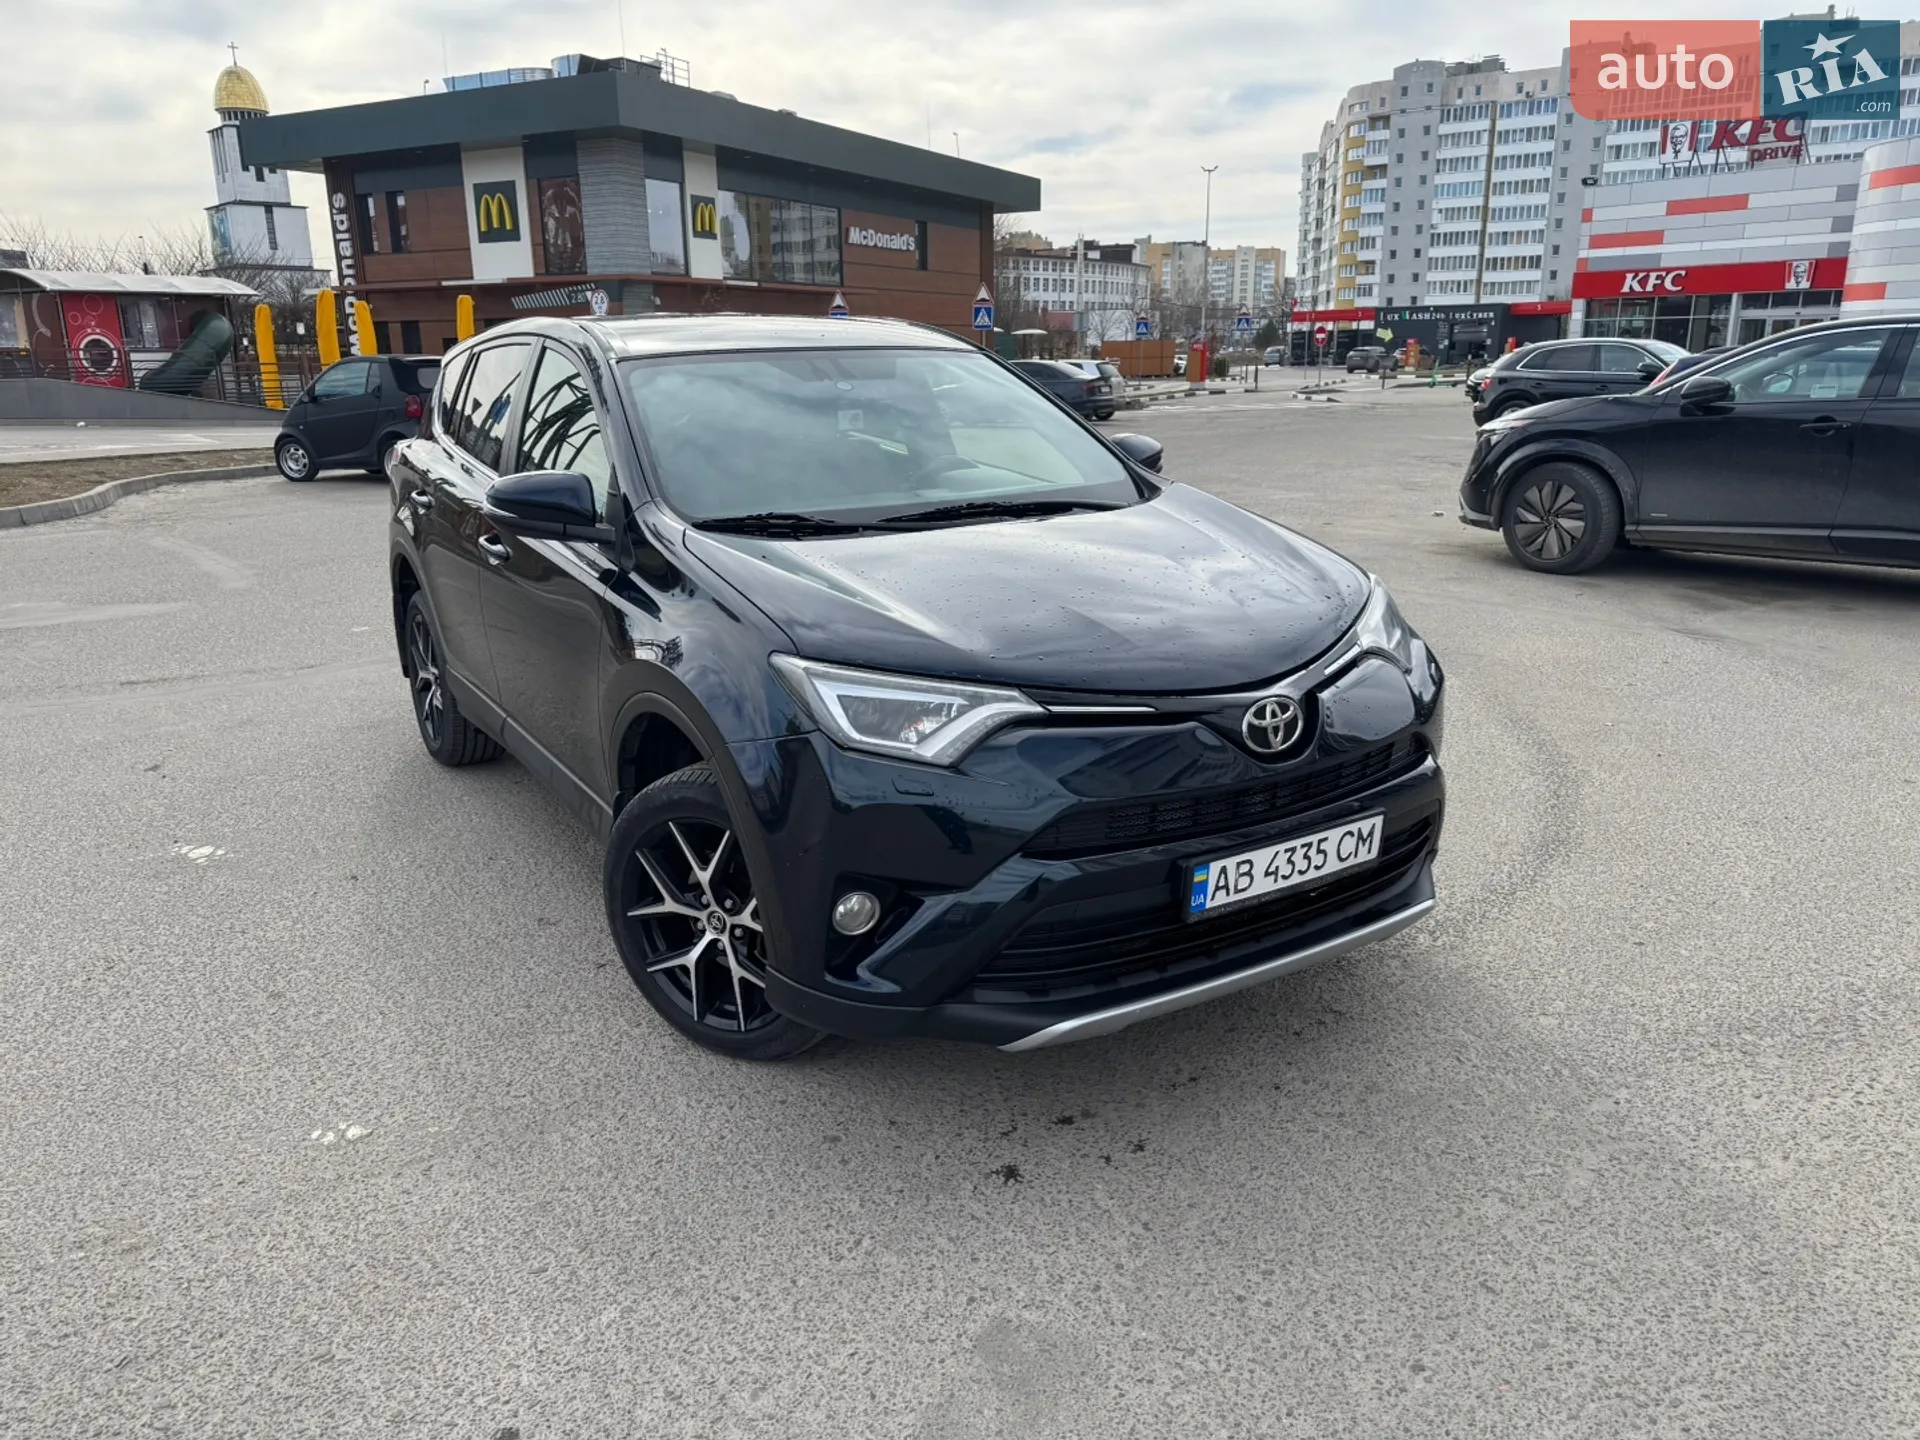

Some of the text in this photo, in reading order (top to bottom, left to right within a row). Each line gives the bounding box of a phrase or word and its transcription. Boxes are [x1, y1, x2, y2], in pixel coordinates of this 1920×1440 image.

[1708, 112, 1807, 150] KFC
[1749, 144, 1804, 162] DRIVE
[848, 226, 915, 250] McDonald's
[1620, 270, 1688, 293] KFC
[1210, 858, 1255, 902] AB
[1263, 836, 1330, 884] 4335
[1336, 822, 1377, 863] CM
[1190, 894, 1205, 907] UA
